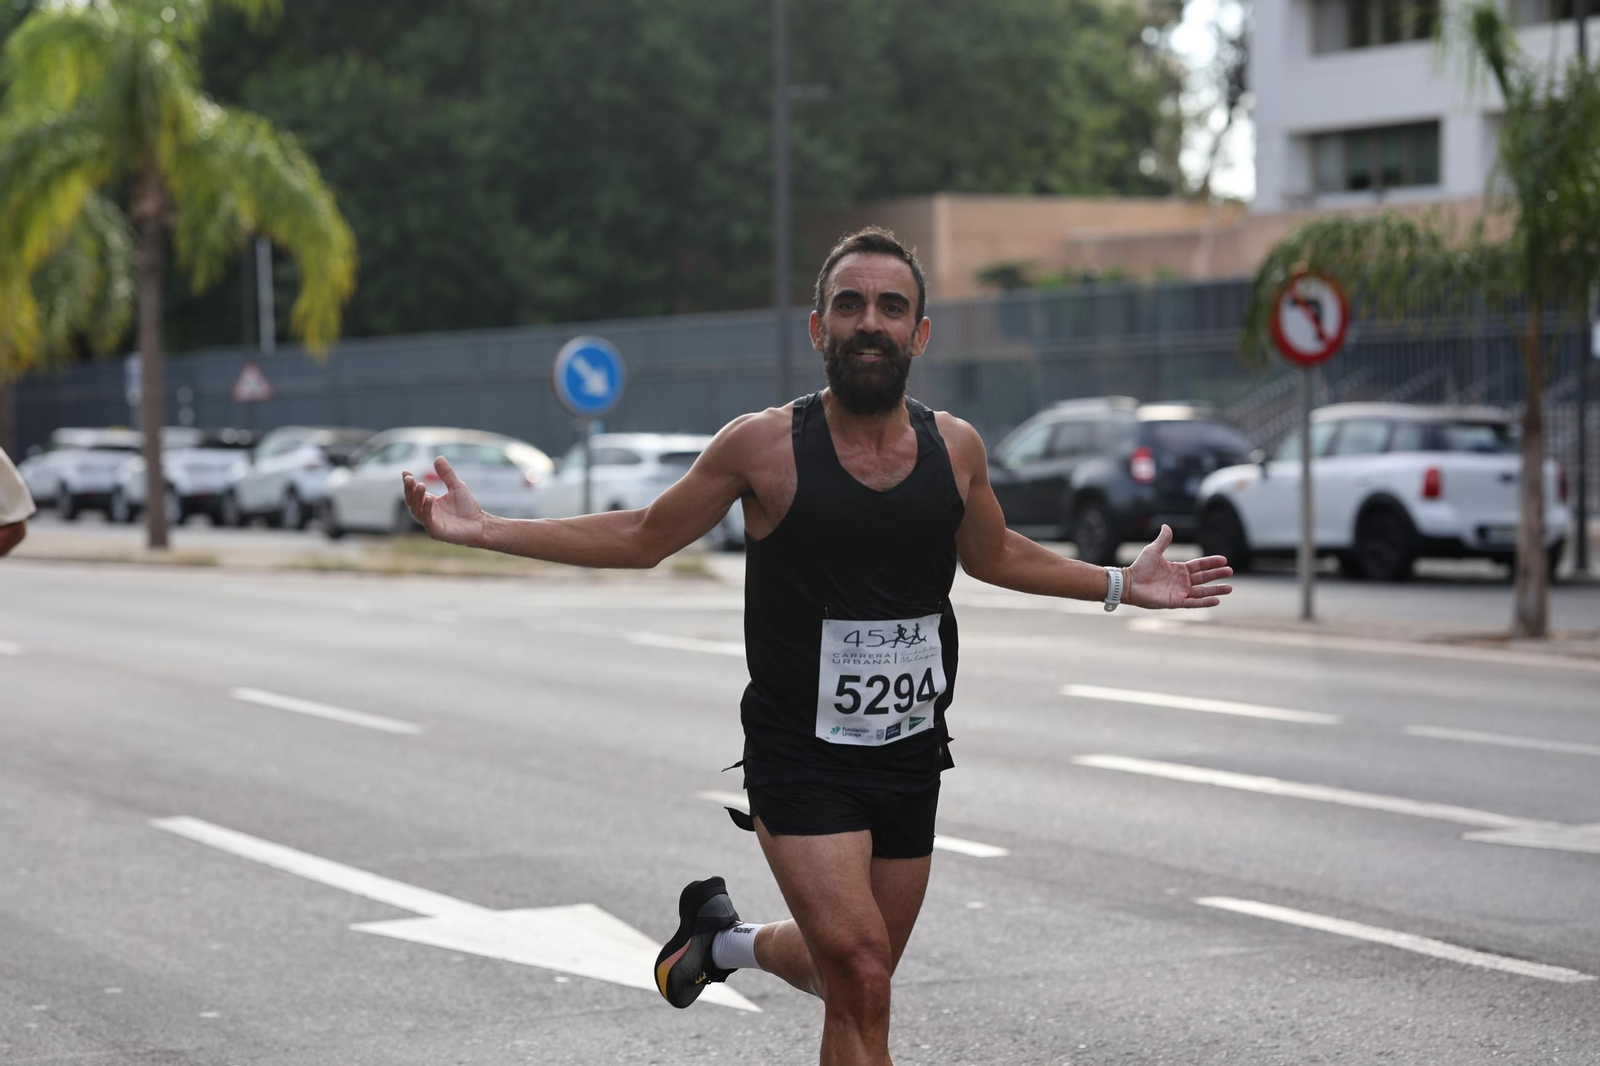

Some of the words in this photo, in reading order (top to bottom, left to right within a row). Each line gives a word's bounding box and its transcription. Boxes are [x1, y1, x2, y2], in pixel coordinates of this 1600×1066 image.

[843, 629, 885, 648] 45
[833, 667, 939, 716] 5294
[842, 731, 862, 739] Unicaja
